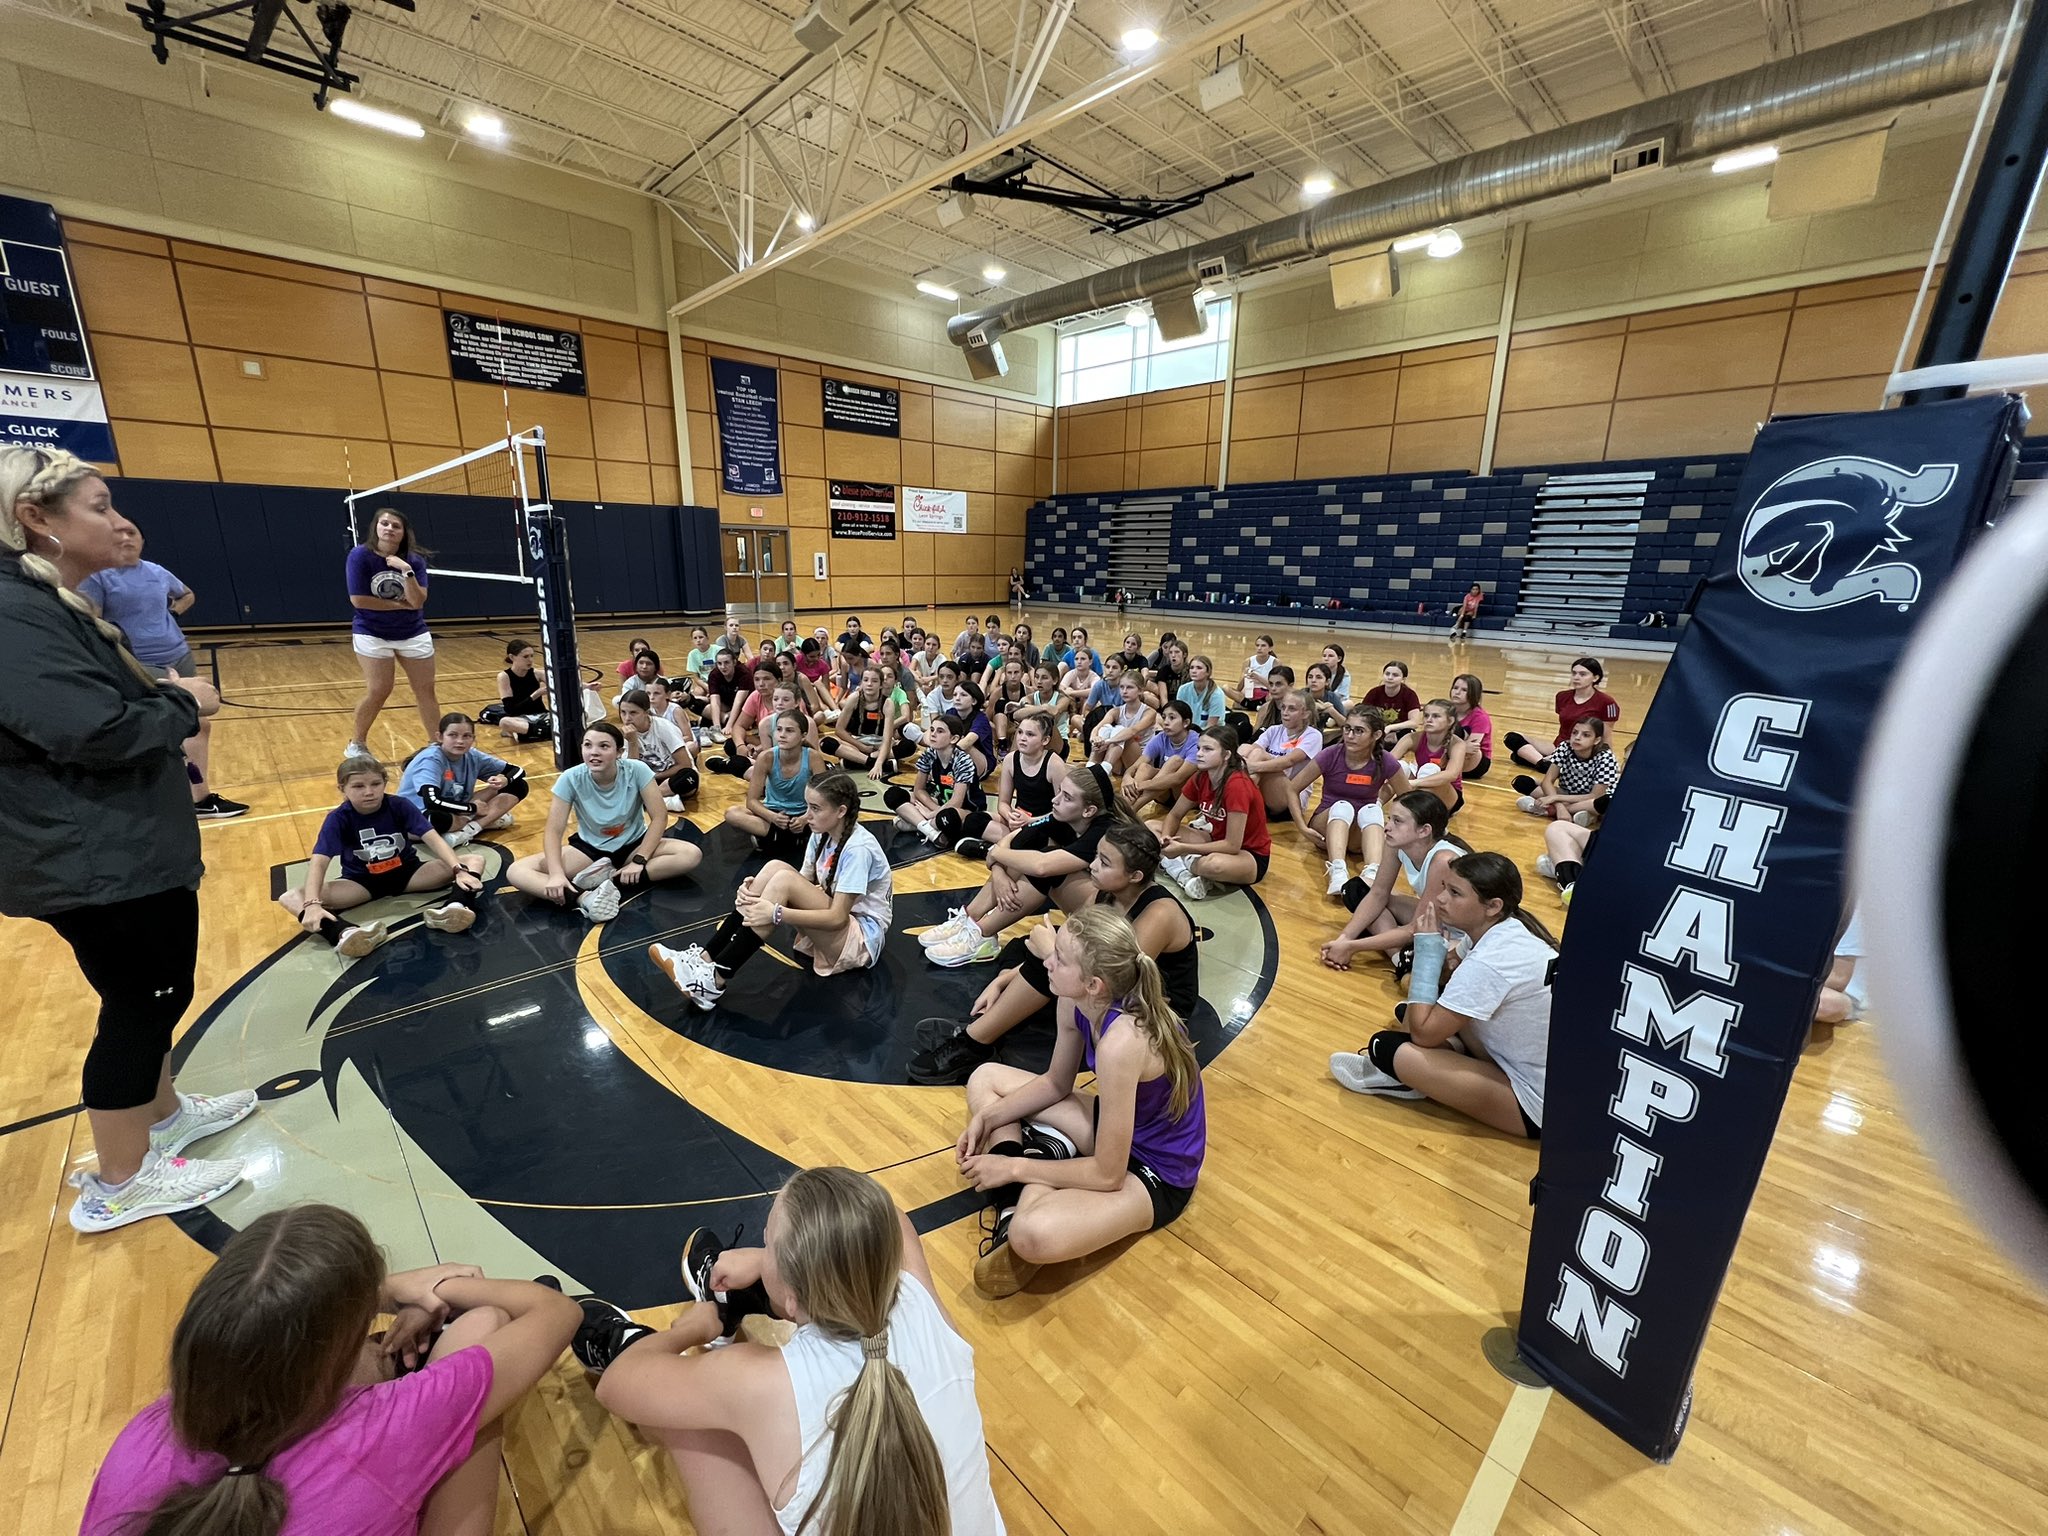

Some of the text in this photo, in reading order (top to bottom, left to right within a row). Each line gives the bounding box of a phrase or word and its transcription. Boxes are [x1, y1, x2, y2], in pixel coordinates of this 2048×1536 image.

[4, 277, 61, 298] GUEST
[41, 328, 78, 342] FOULS
[475, 322, 553, 342] CHAMON SCHOOL SONG
[50, 364, 88, 377] SCORE
[8, 424, 60, 438] GLICK
[1546, 691, 1813, 1380] CHAMPION
